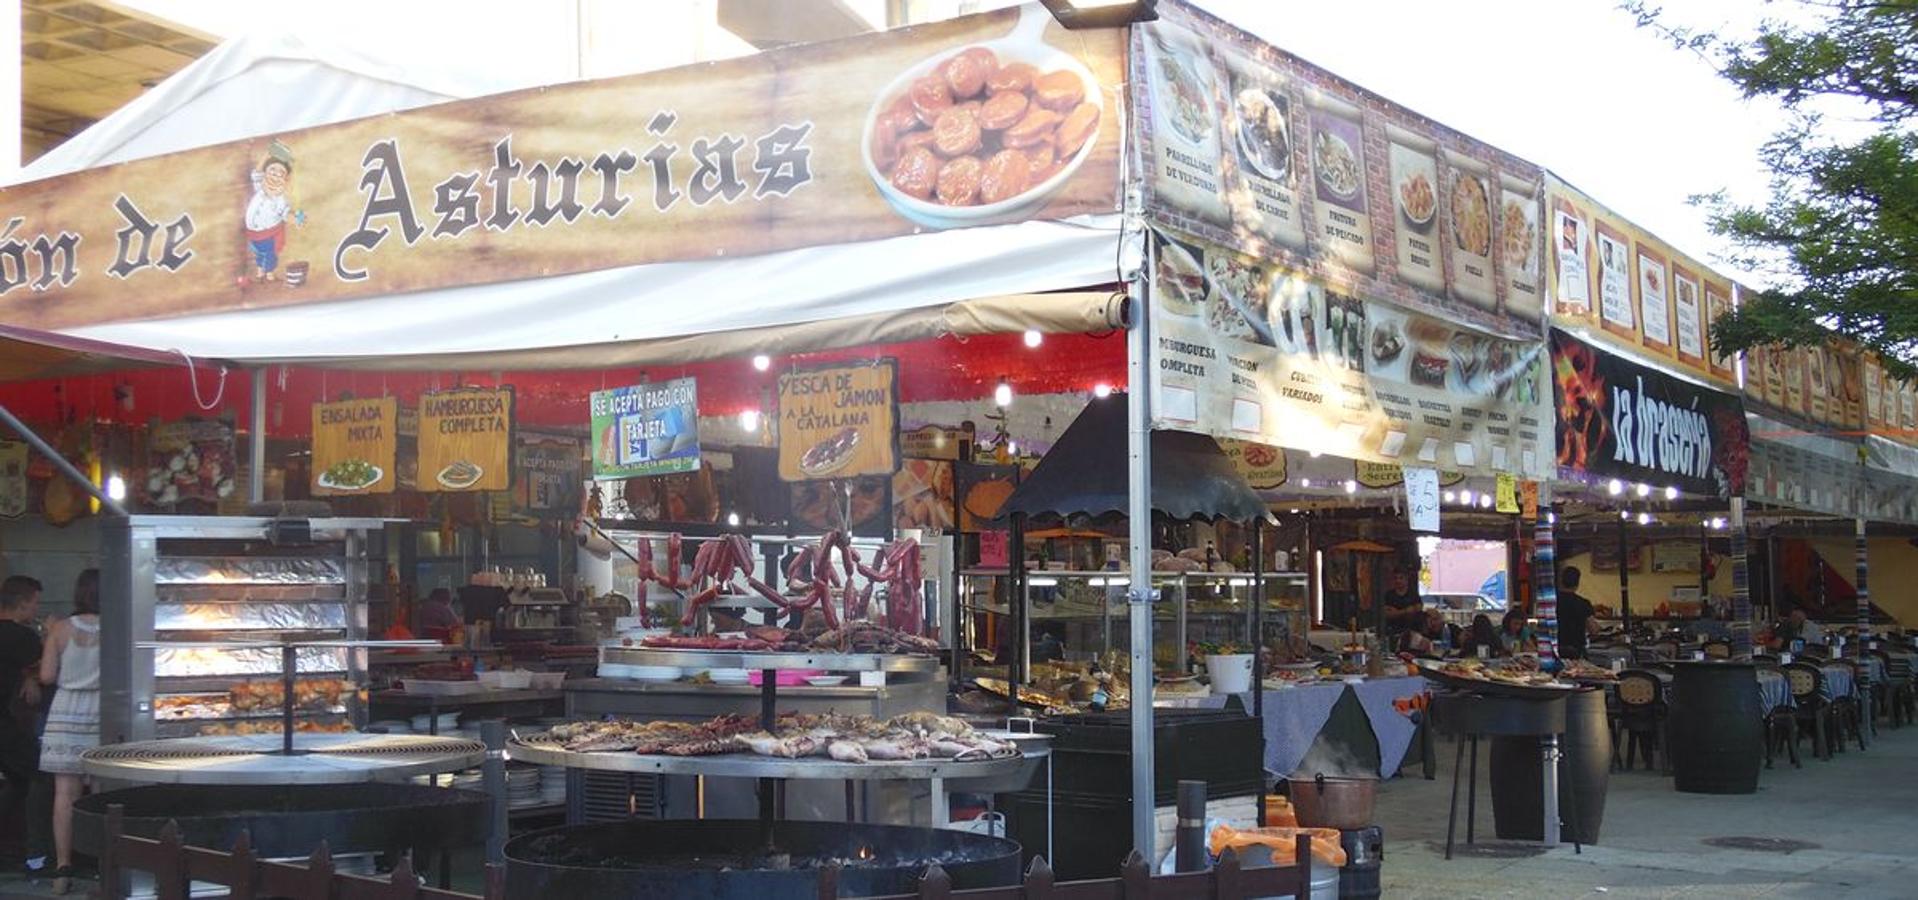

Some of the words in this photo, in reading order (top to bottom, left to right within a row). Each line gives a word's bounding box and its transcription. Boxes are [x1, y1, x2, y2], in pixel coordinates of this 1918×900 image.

[1166, 165, 1178, 179] DE
[107, 193, 196, 280] de
[333, 106, 815, 281] Asturias
[778, 376, 831, 396] YESCA
[835, 374, 852, 391] DE
[425, 398, 504, 418] HAMBURGUESA
[595, 400, 606, 416] SE
[610, 394, 644, 414] ACEPTA
[645, 389, 671, 410] PAGO
[672, 386, 694, 405] CON
[835, 388, 885, 408] JAMON
[320, 405, 382, 425] ENSALADA
[786, 408, 795, 419] A
[800, 405, 815, 418] LA
[797, 411, 869, 430] CATALANA
[347, 425, 383, 441] MIXTA
[439, 416, 506, 434] COMPLETA
[625, 419, 667, 440] TARJETA
